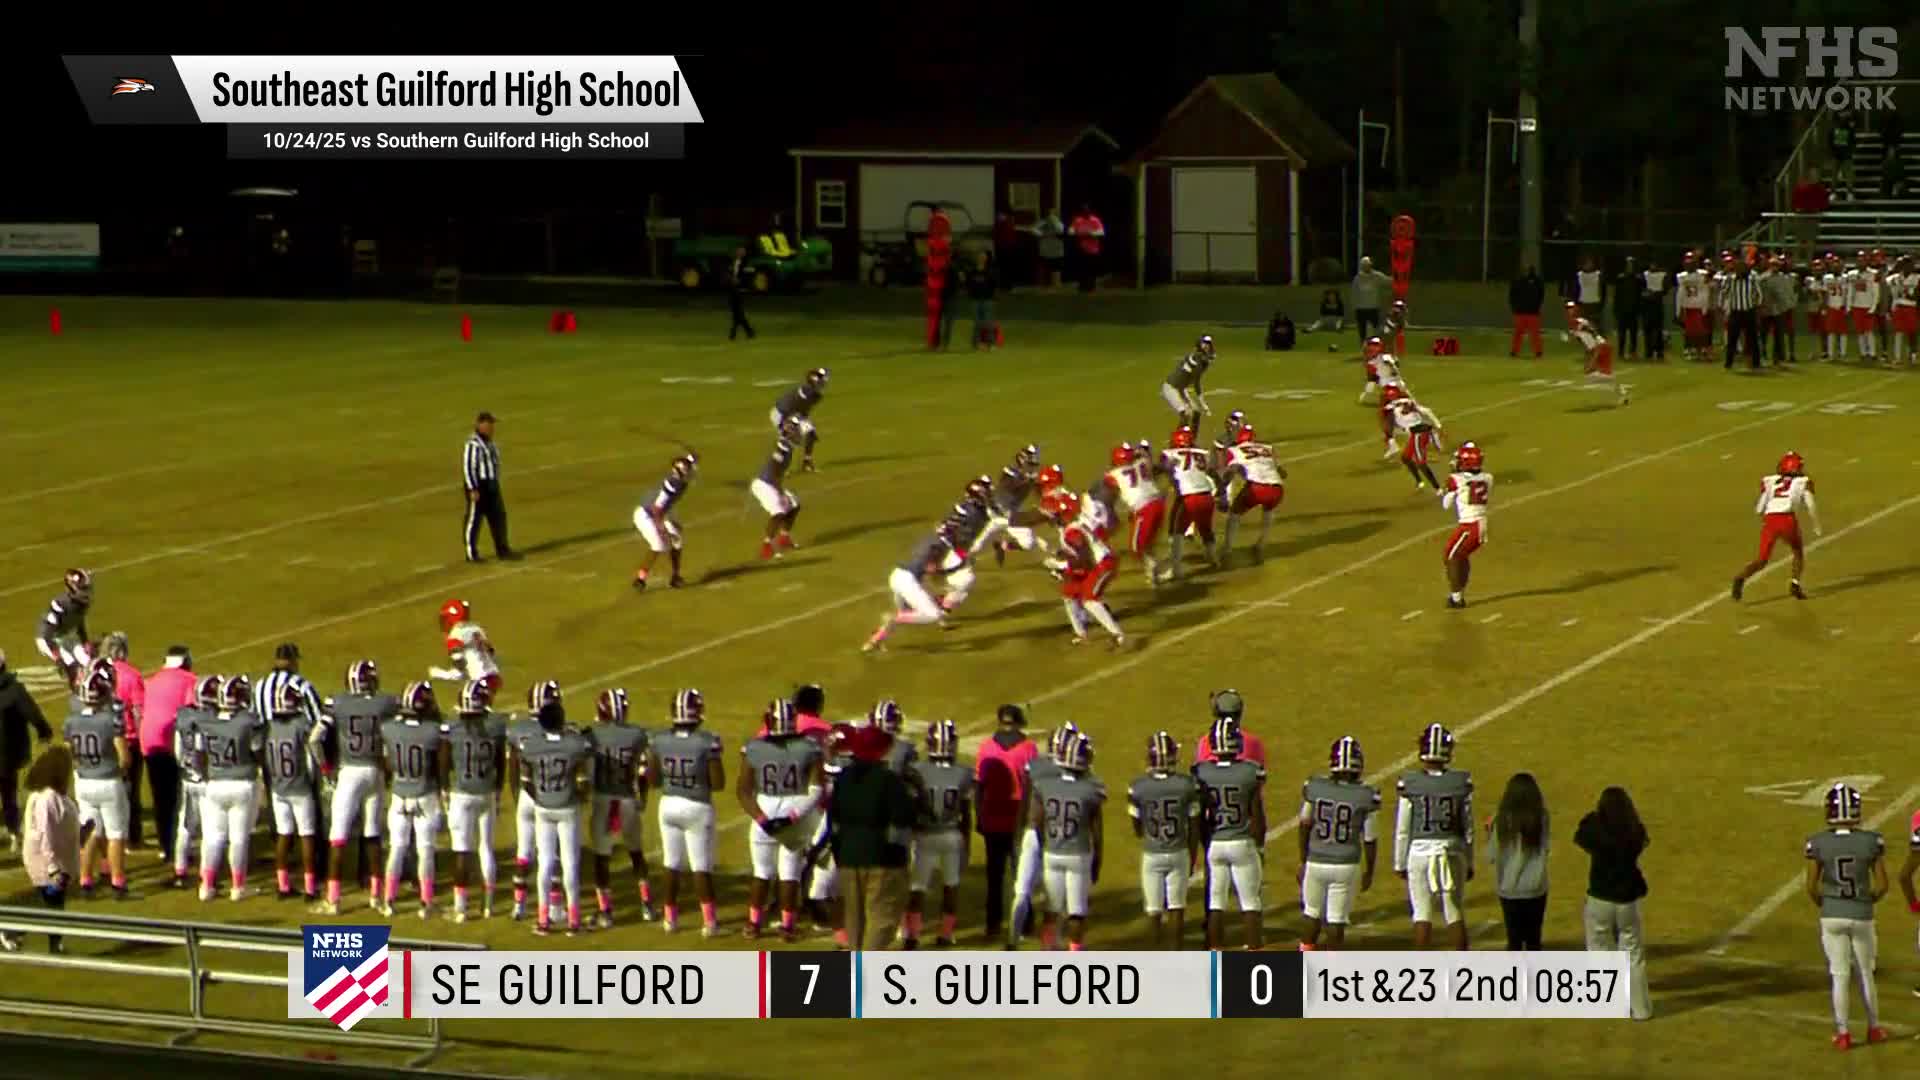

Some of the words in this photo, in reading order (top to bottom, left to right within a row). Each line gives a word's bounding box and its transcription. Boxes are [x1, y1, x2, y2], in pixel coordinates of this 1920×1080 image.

[1466, 479, 1489, 506] 12
[1774, 476, 1793, 498] 2
[205, 734, 239, 769] 54
[266, 739, 297, 782] 16
[394, 741, 424, 780] 10
[761, 761, 799, 796] 64
[1144, 798, 1179, 842] 65
[1315, 798, 1353, 846] 58
[1422, 794, 1457, 833] 13
[1835, 856, 1858, 900] 5
